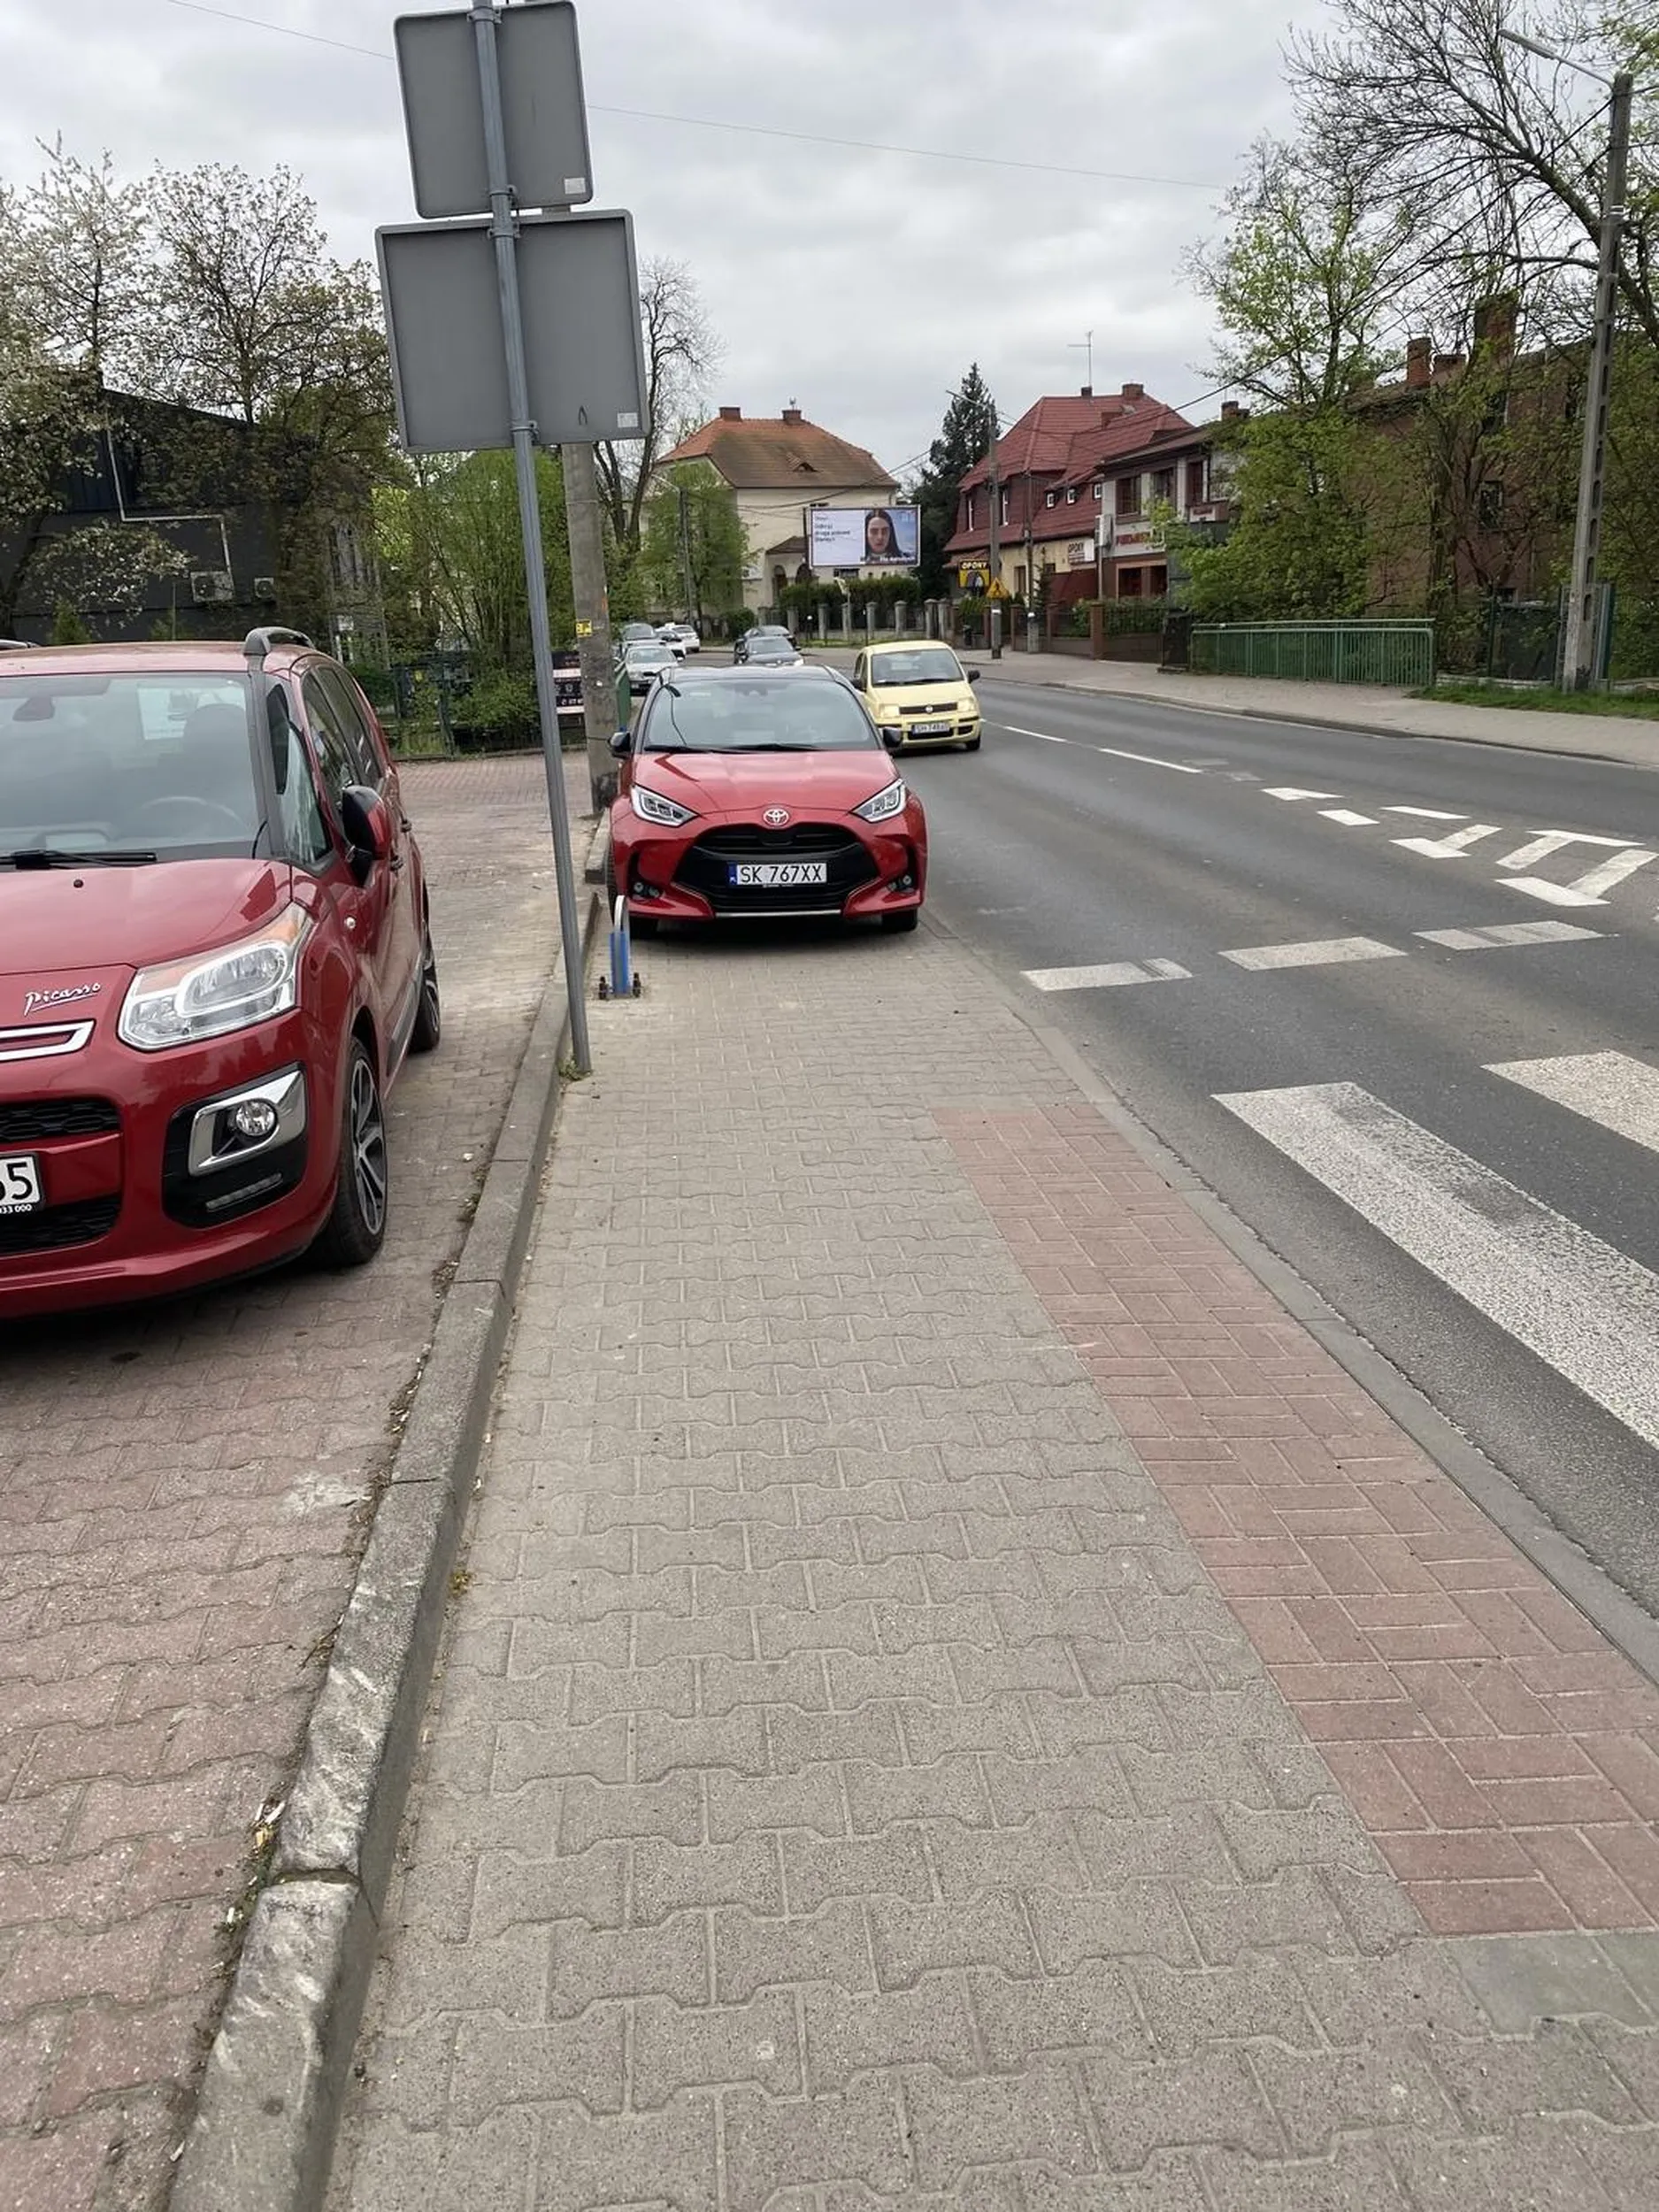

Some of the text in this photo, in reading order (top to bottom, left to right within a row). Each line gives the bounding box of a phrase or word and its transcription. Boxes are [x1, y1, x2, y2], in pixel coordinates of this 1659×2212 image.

[741, 864, 822, 883] SK 767XX
[24, 980, 102, 1017] Picasso
